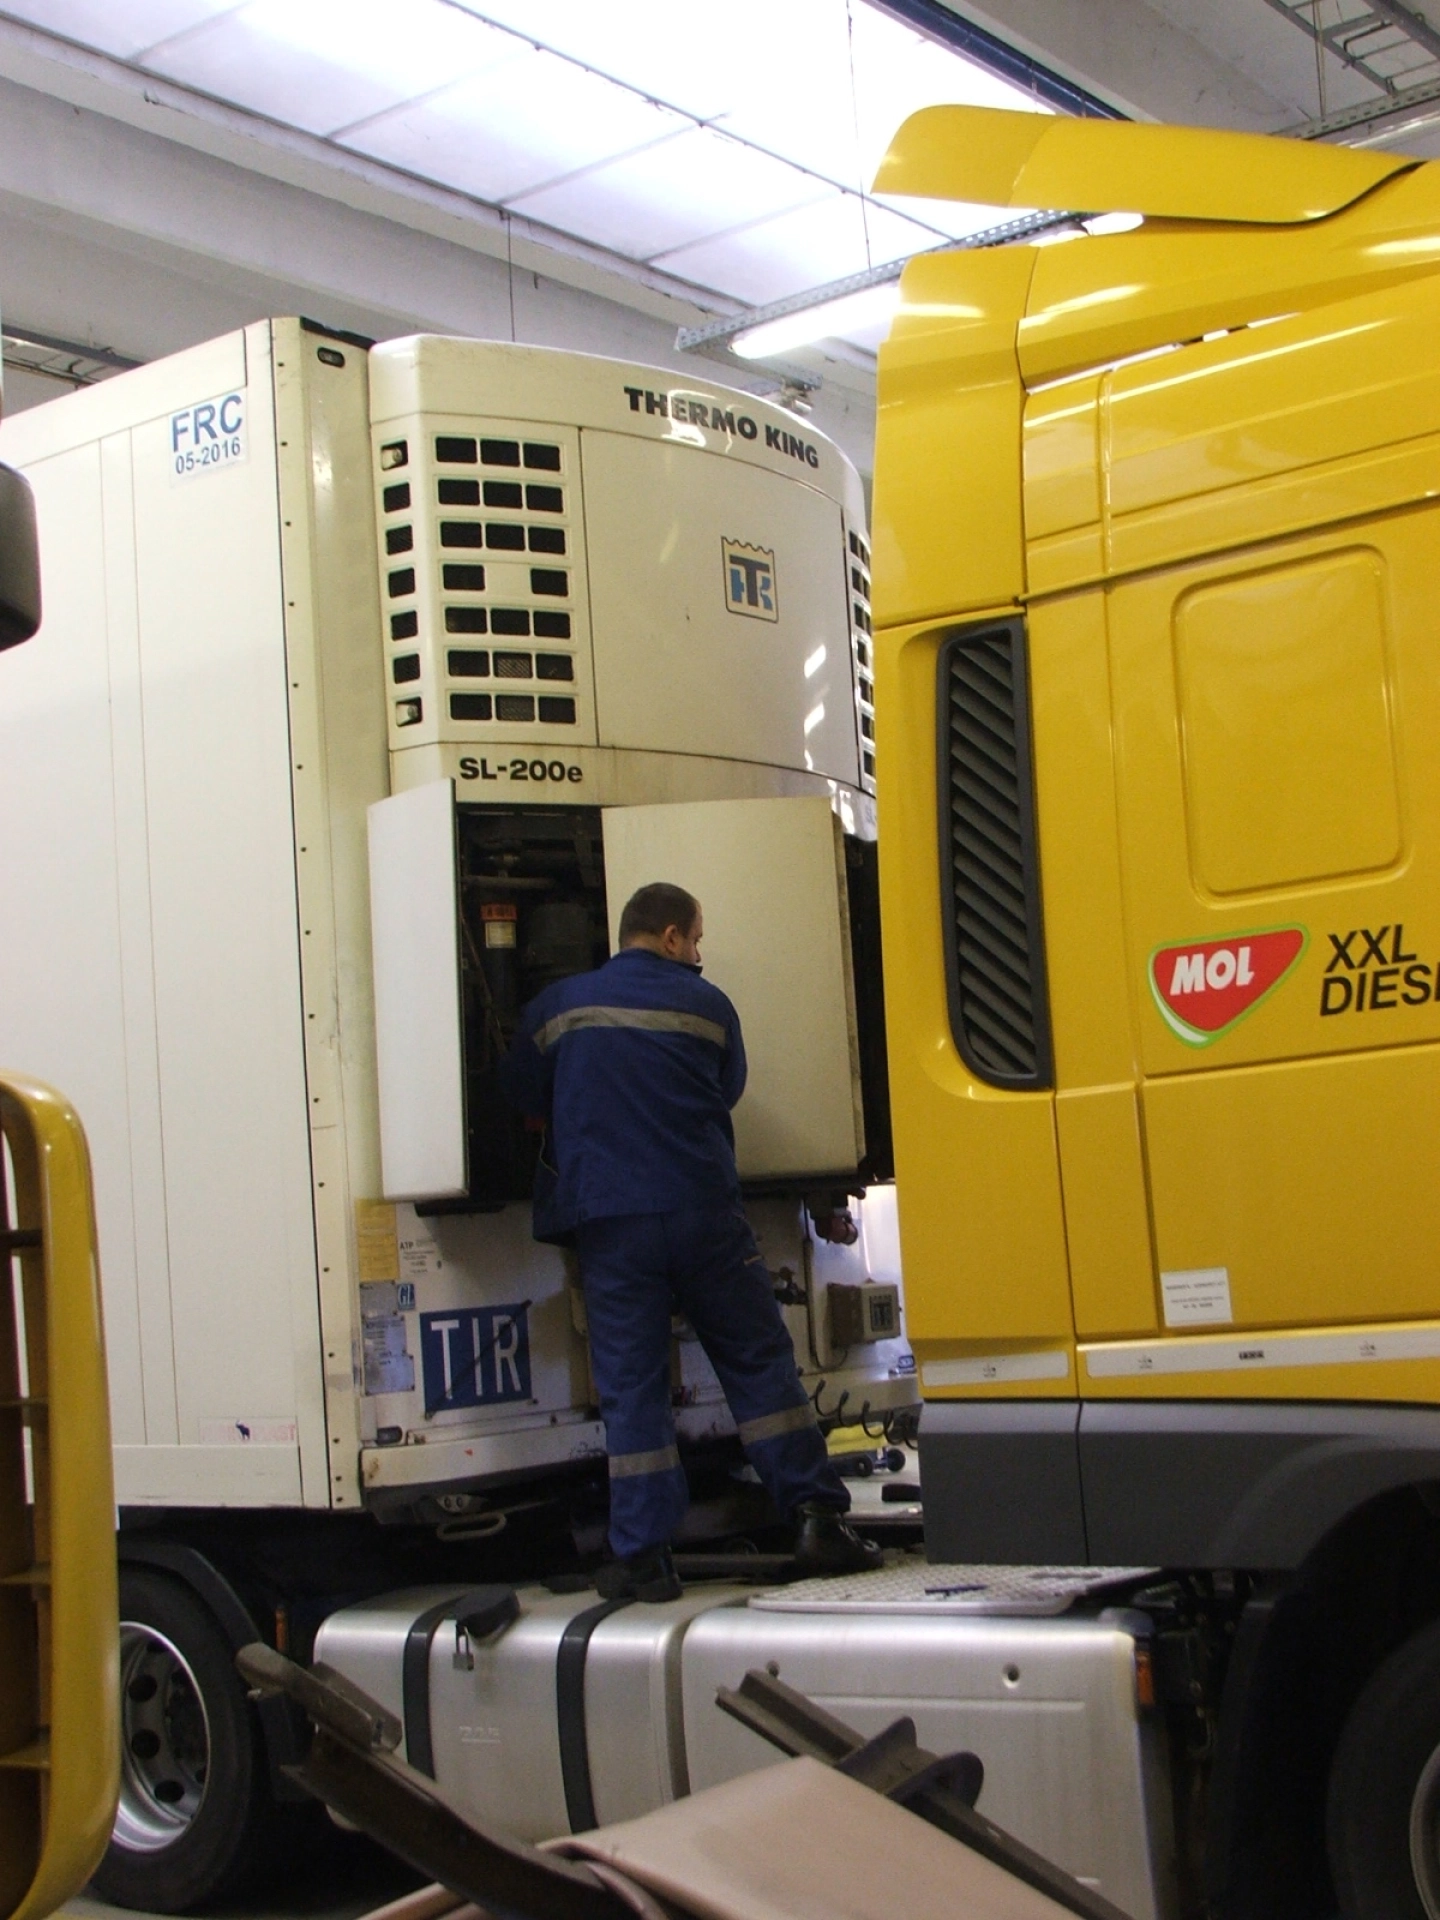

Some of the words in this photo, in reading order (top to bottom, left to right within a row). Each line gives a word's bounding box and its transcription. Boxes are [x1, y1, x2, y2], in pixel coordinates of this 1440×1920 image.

[172, 394, 243, 453] FRC
[623, 386, 758, 440] THERMO
[764, 424, 819, 469] KING
[175, 436, 241, 475] 05-2016
[459, 757, 583, 783] SL-200e
[1170, 946, 1255, 996] MOL
[1324, 924, 1417, 973] XXL
[430, 1314, 523, 1400] TIR
